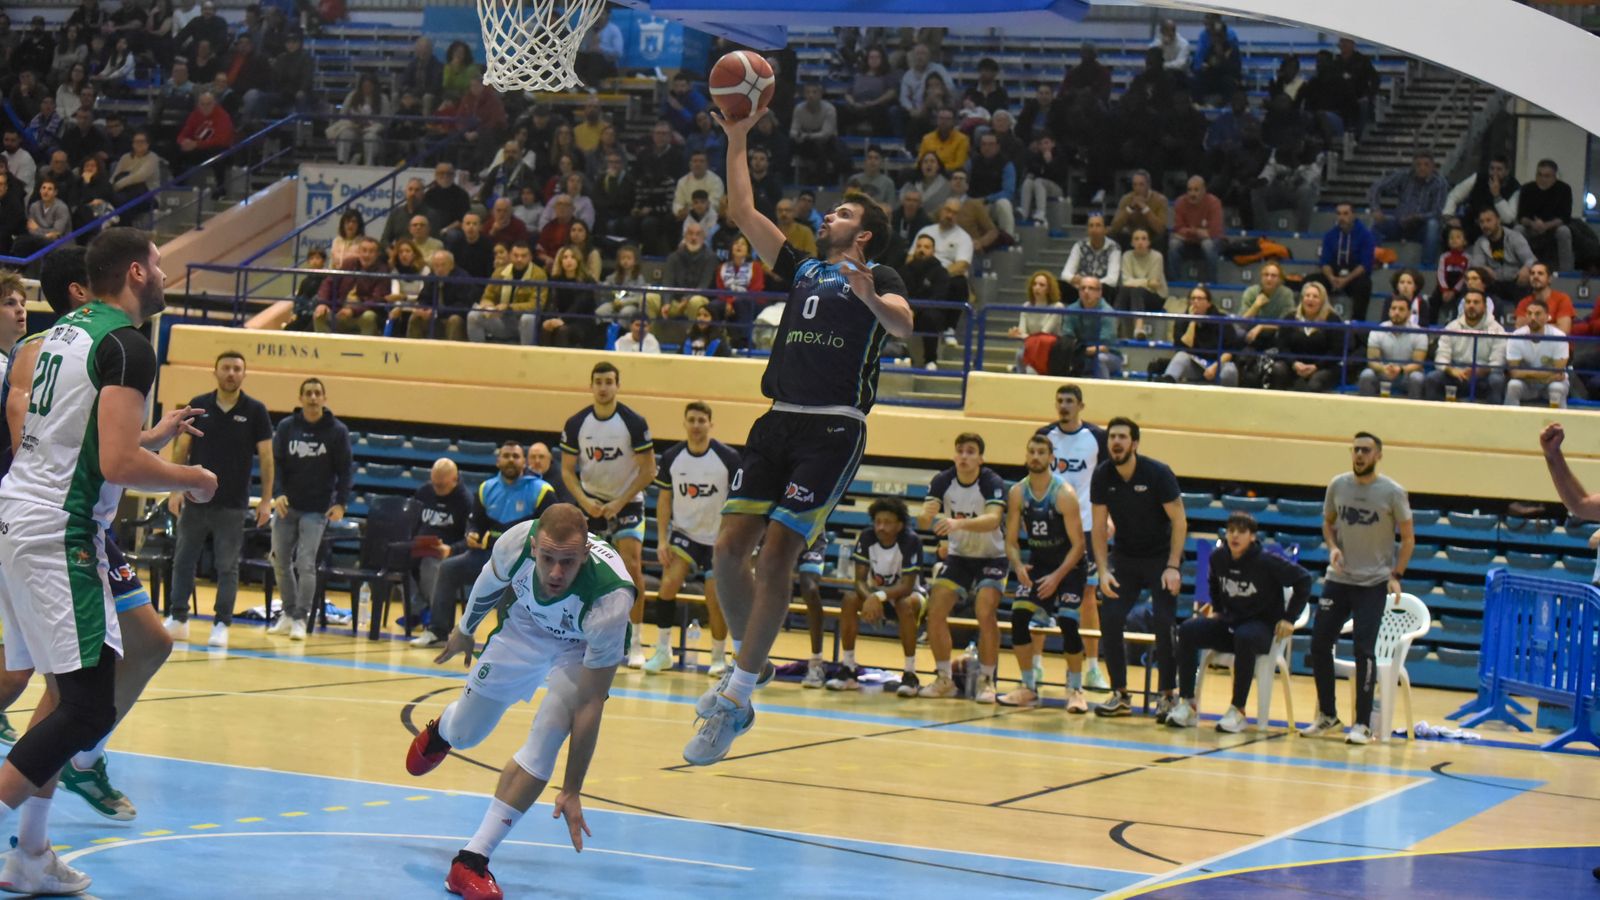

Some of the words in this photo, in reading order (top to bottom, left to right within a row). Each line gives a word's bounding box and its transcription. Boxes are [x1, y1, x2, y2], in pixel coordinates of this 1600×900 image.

[802, 295, 819, 319] 0
[256, 343, 319, 359] PRENSA
[383, 351, 402, 364] TV
[28, 351, 63, 417] 20
[289, 440, 327, 458] UDEA
[586, 447, 624, 462] UDEA
[731, 468, 744, 491] 0
[679, 483, 719, 499] UDEA
[1032, 521, 1049, 536] 22
